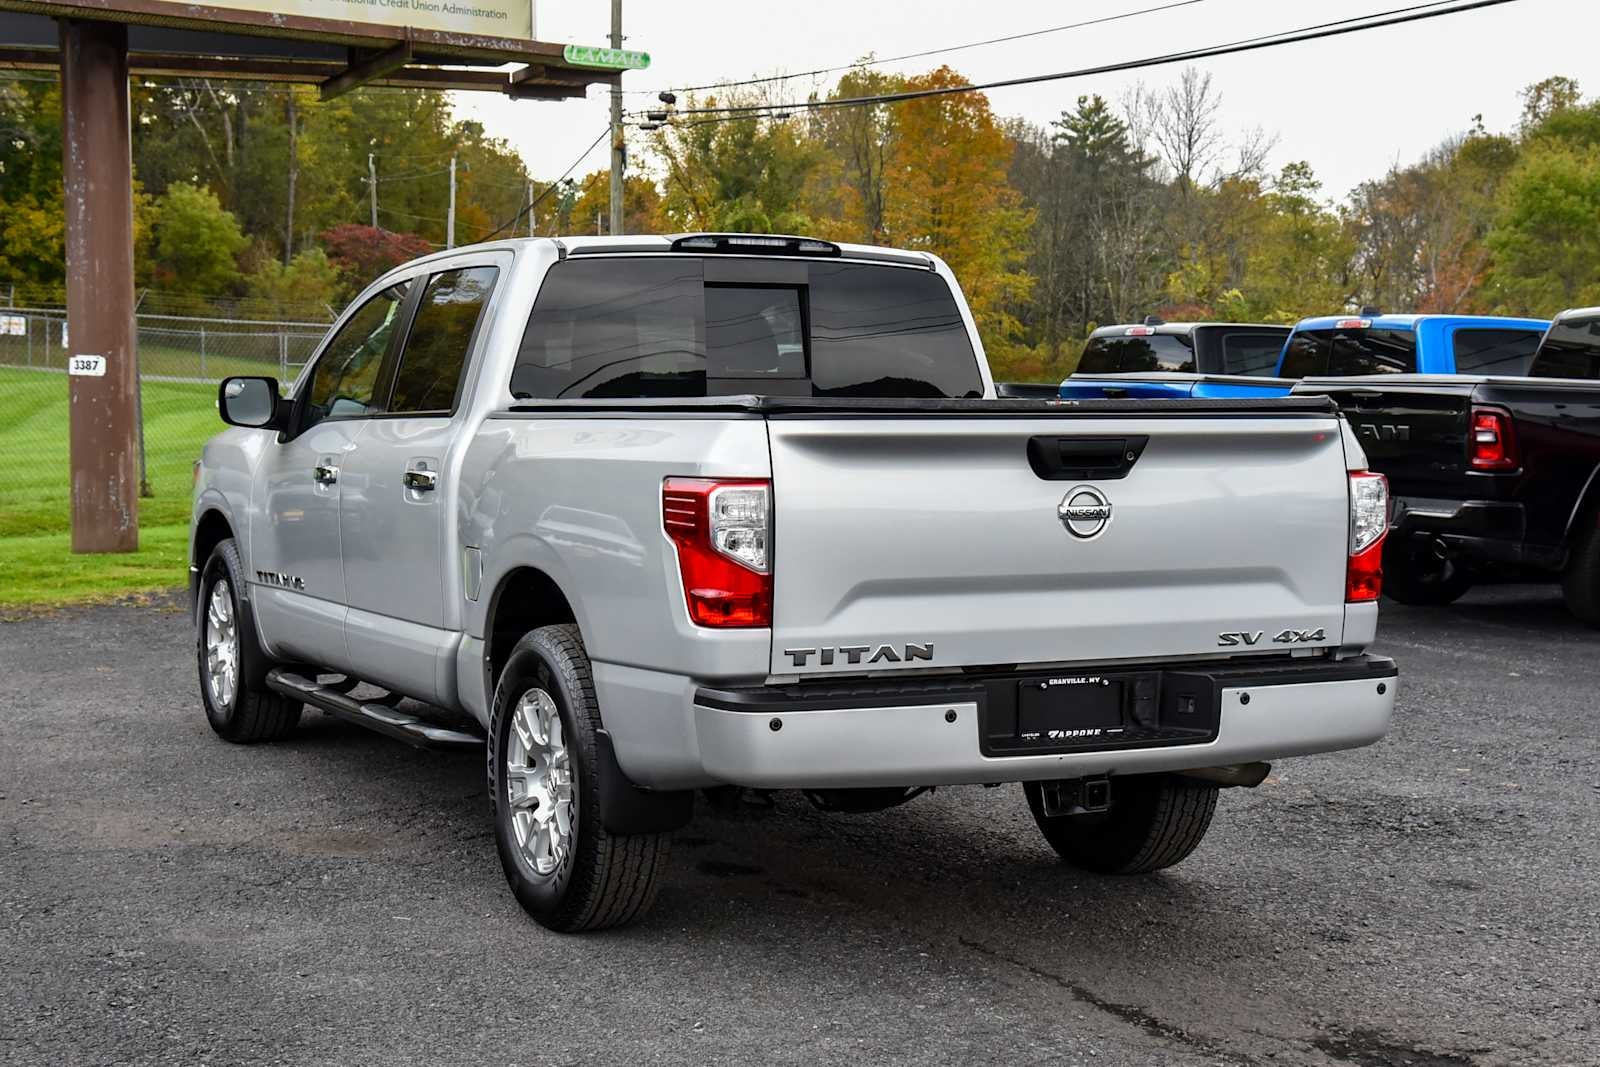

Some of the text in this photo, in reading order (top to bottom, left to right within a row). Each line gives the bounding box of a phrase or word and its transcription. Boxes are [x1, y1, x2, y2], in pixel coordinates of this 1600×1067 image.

[379, 0, 409, 9] Credit
[411, 0, 440, 13] Union
[441, 3, 508, 20] Administration
[571, 47, 641, 65] LAMAR
[73, 359, 99, 371] 3387
[1357, 423, 1411, 441] AM
[1065, 508, 1111, 519] NISSAN
[1217, 631, 1264, 646] SV
[784, 642, 935, 667] TITAN
